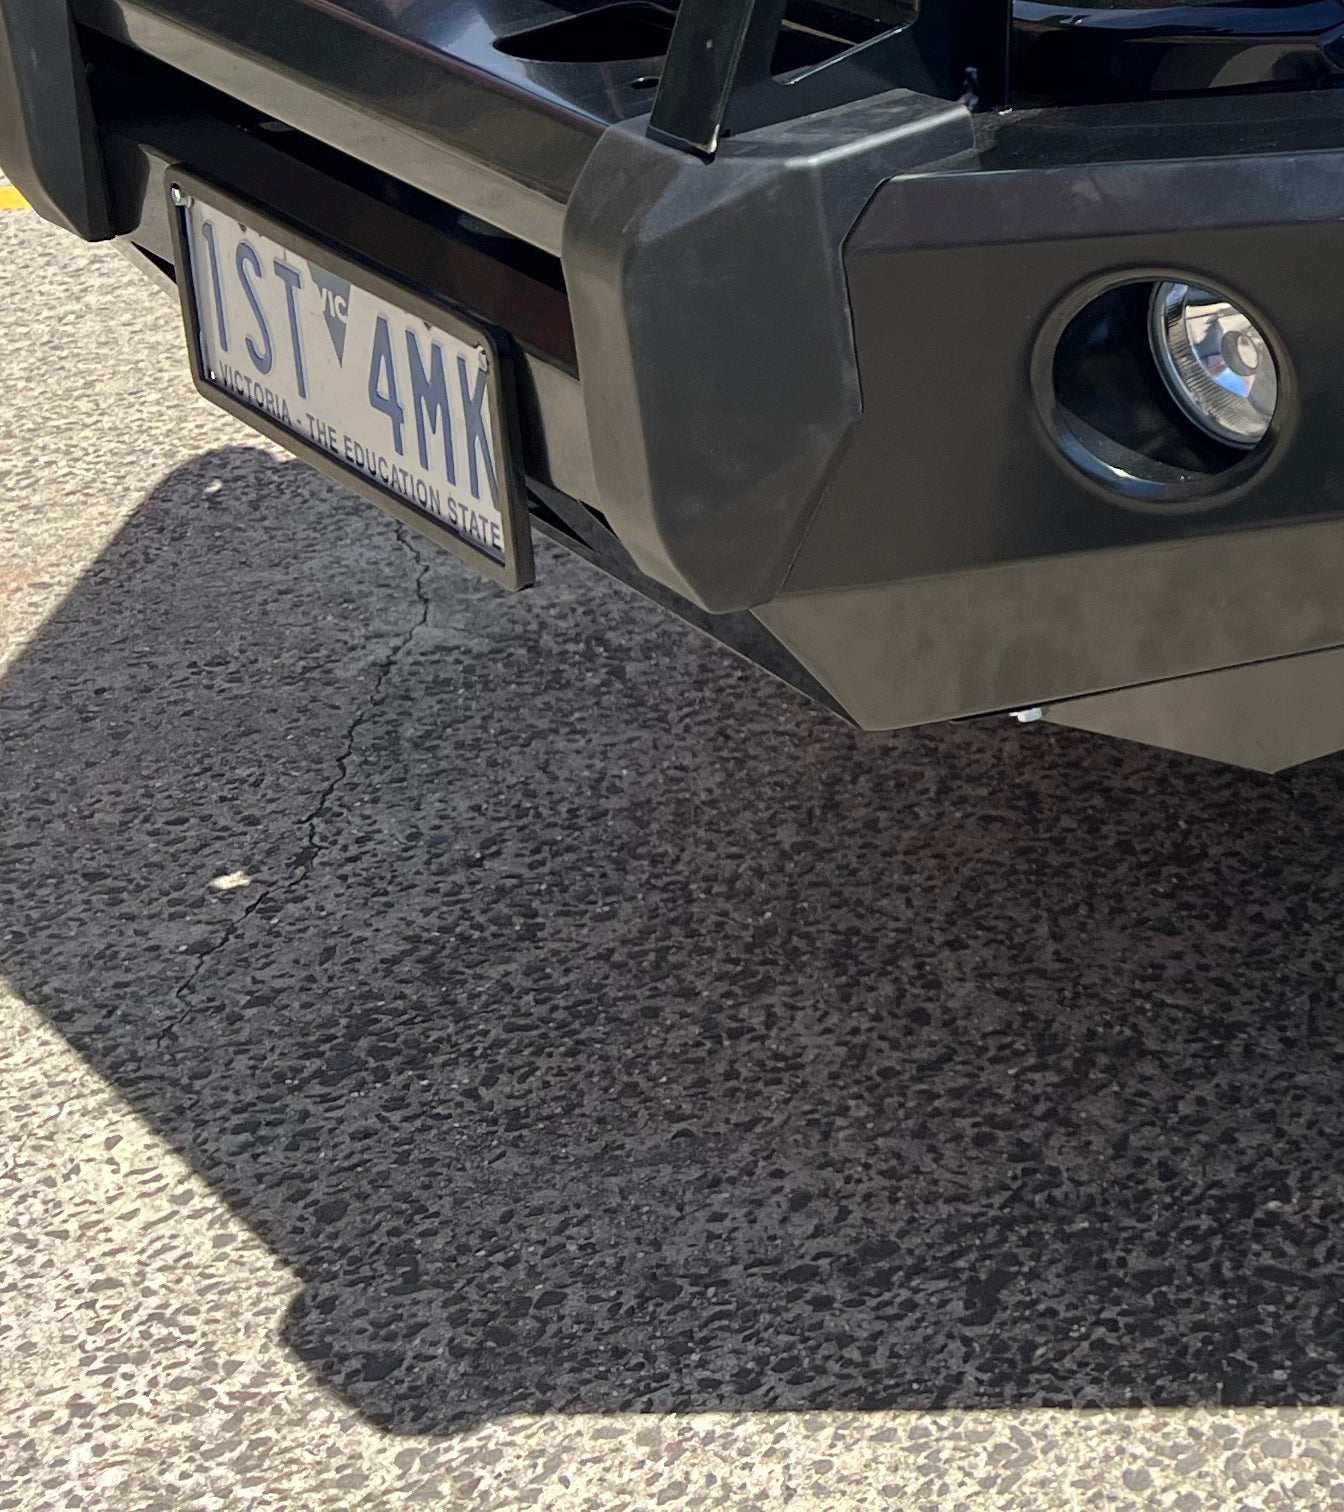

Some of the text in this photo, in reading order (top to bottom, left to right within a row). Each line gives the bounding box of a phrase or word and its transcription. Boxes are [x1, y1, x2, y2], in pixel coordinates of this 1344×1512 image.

[201, 220, 500, 510] 1ST 4MK
[319, 287, 349, 323] VIC
[218, 361, 291, 424] VICTORIA
[306, 413, 338, 451] THE
[344, 434, 441, 515] EDUCATION
[448, 501, 503, 550] STATE
